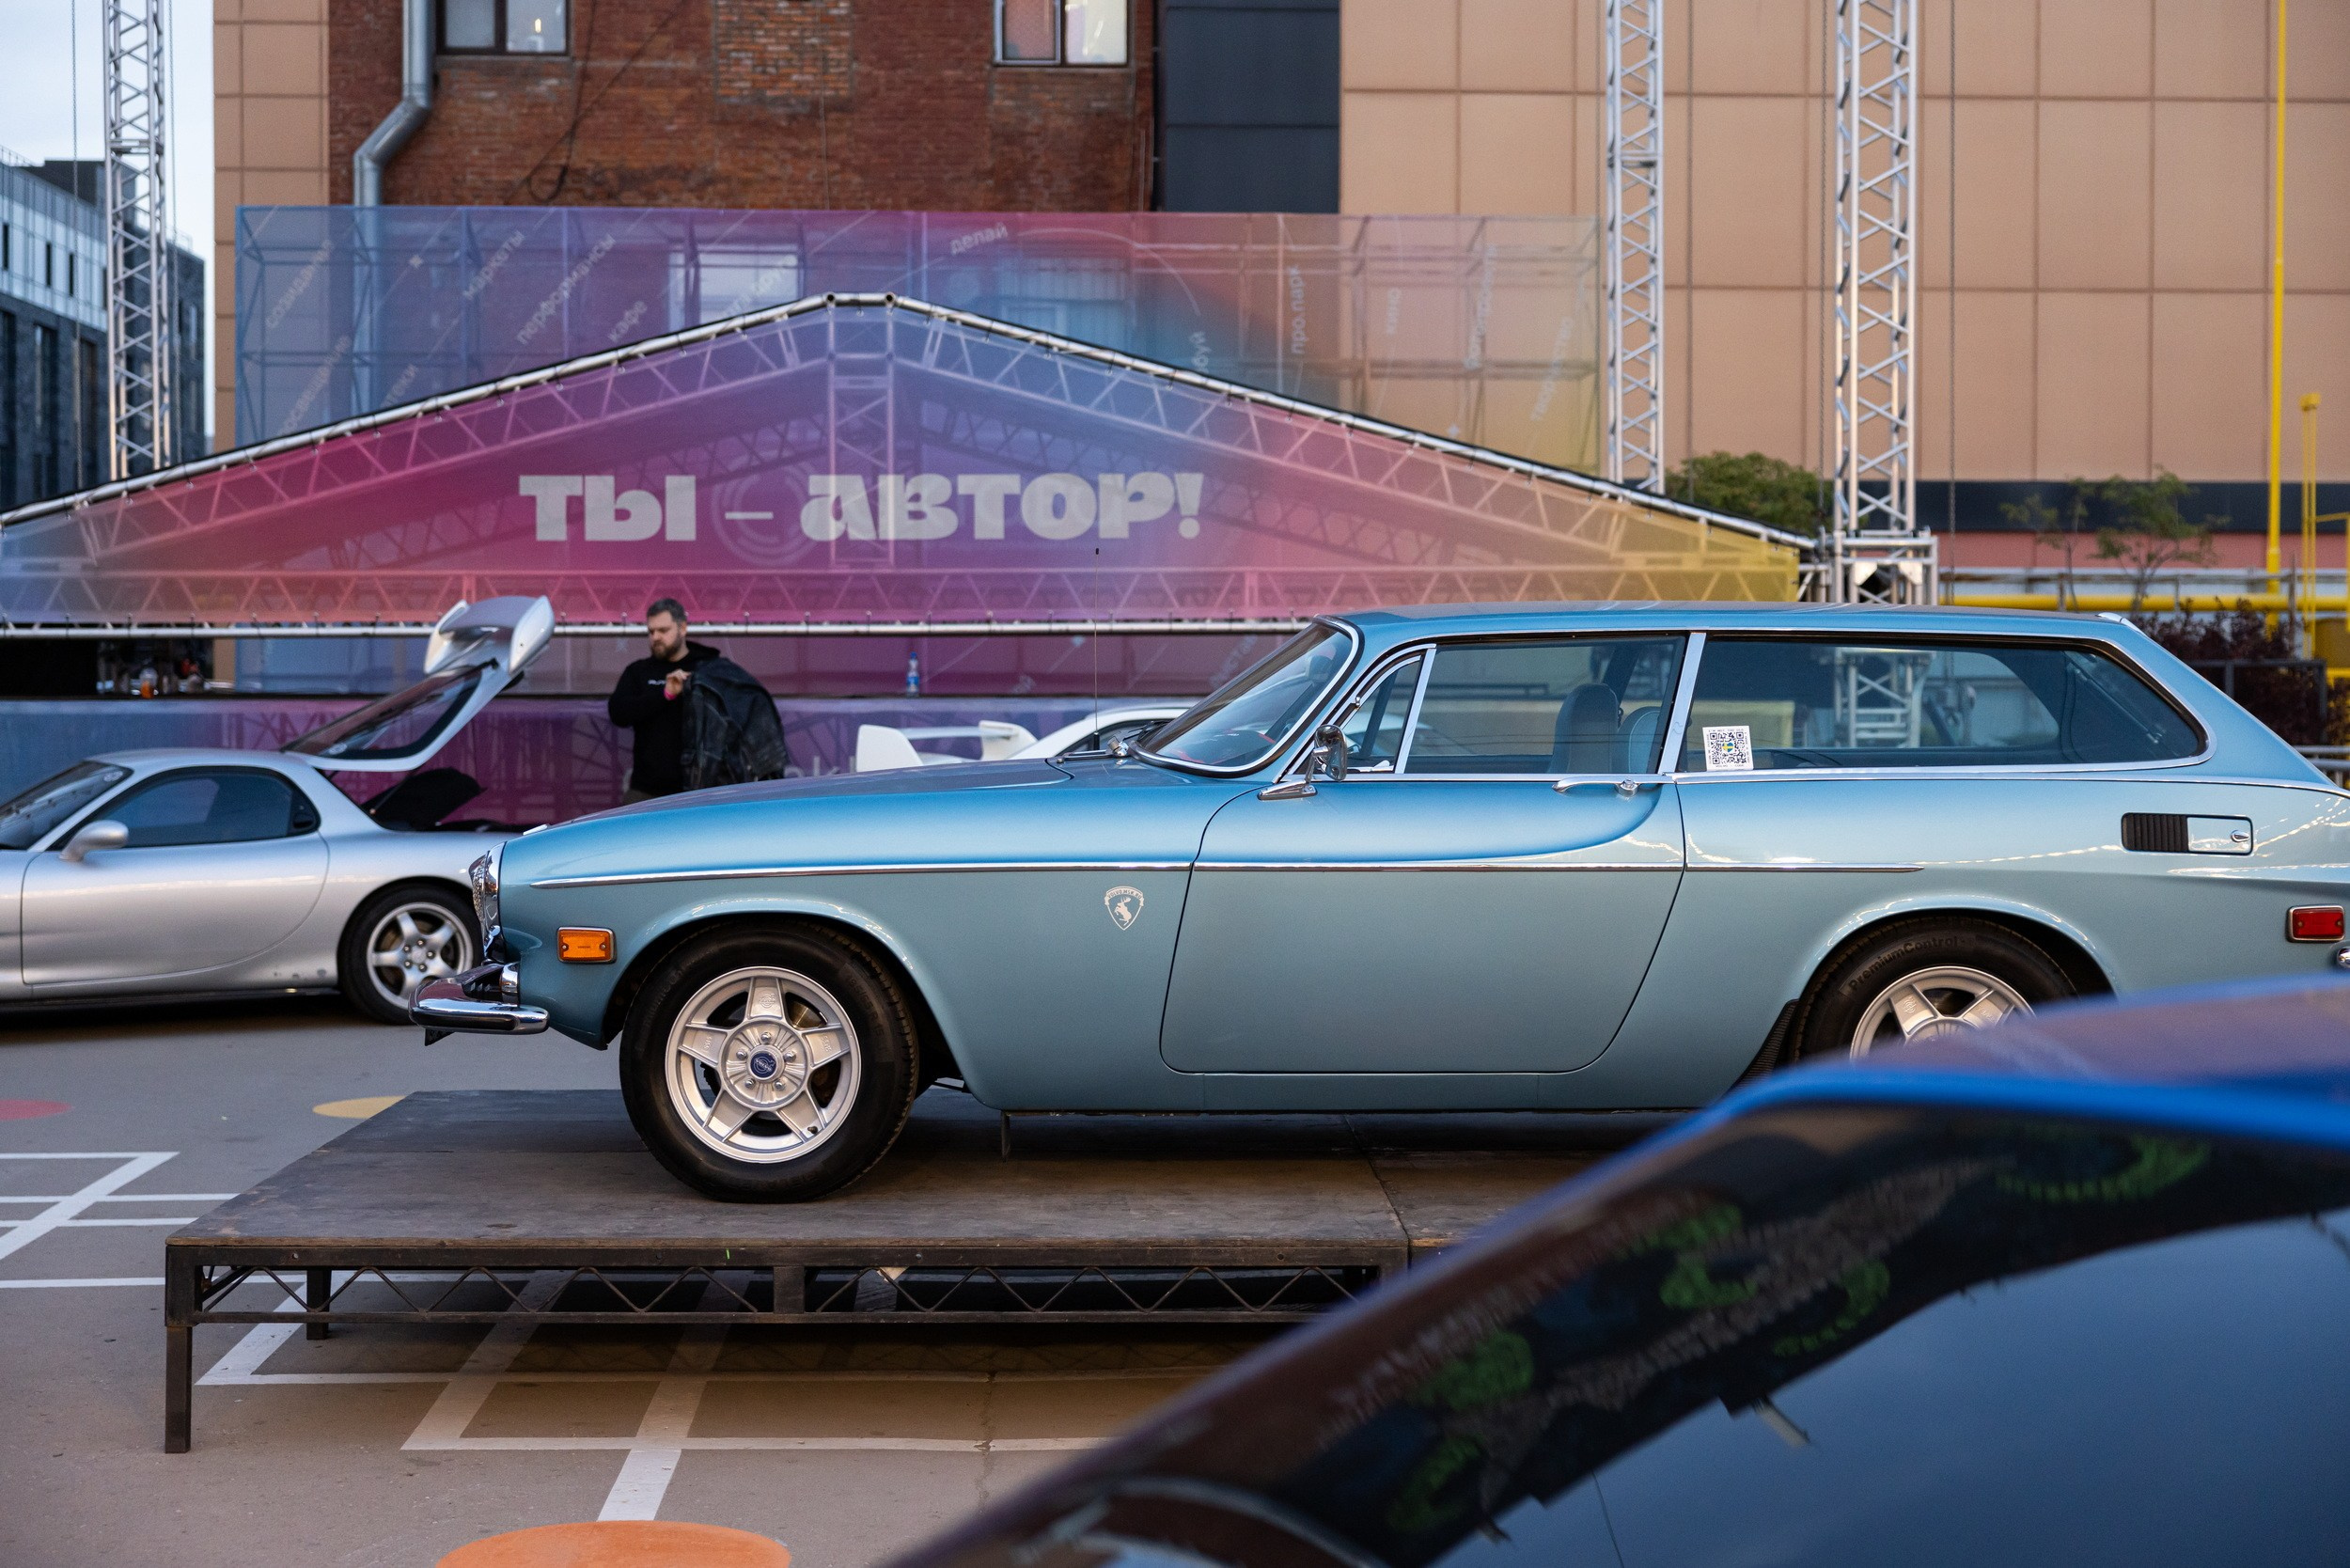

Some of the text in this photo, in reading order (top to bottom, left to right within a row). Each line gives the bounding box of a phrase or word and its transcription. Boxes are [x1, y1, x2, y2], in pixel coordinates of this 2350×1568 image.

[461, 228, 526, 301] маркеты
[949, 222, 1009, 255] делай
[515, 232, 618, 345] перформансы
[606, 298, 649, 344] кафе
